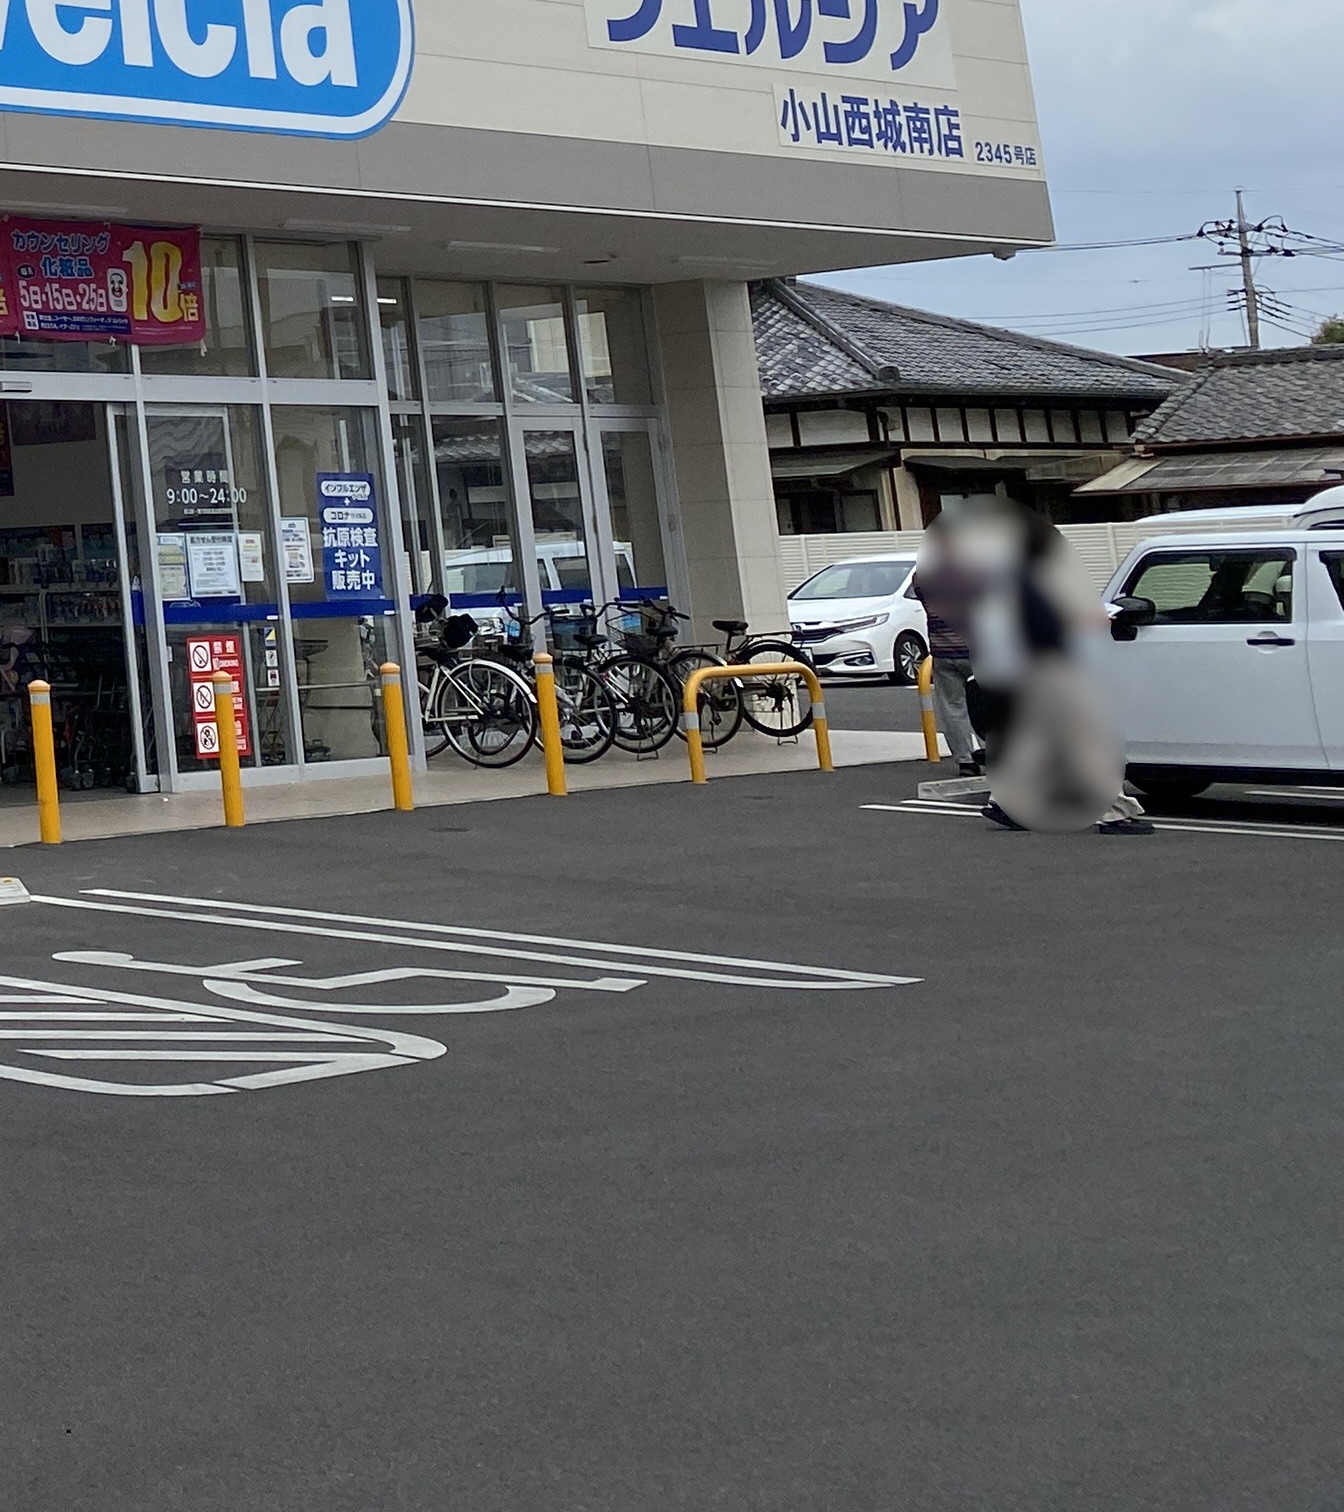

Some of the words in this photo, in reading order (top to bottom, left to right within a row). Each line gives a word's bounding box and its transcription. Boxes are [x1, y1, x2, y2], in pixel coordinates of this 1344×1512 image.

[781, 88, 964, 158] 小山西城南店
[12, 229, 111, 255] カウンセリング
[40, 255, 95, 279] 化粧品
[323, 527, 378, 547] 抗原検査
[334, 550, 371, 568] キット
[331, 570, 375, 590] 販売中
